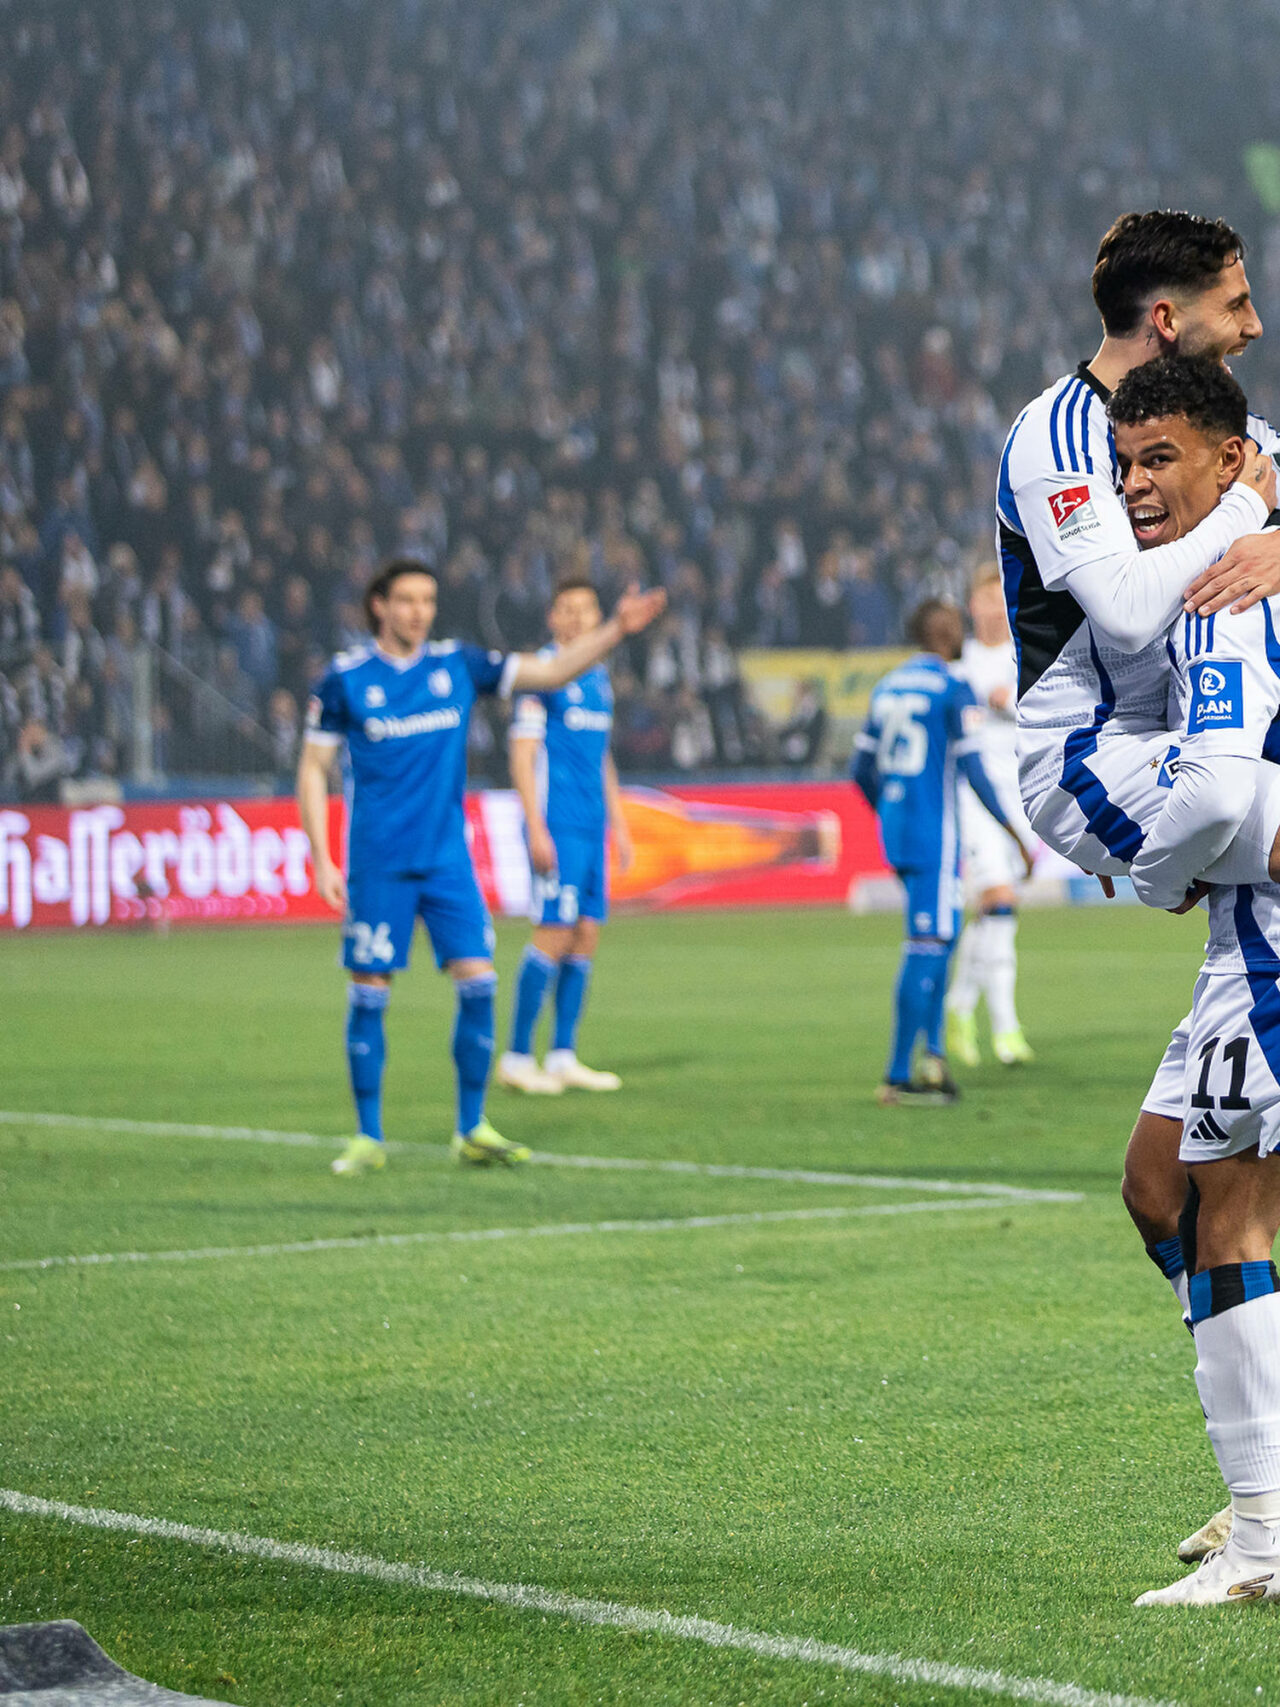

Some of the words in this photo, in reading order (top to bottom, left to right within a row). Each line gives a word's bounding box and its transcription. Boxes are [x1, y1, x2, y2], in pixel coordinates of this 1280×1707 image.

[1060, 521, 1101, 541] BUNDESLIGA
[351, 921, 396, 965] 24
[1191, 1036, 1251, 1110] 11
